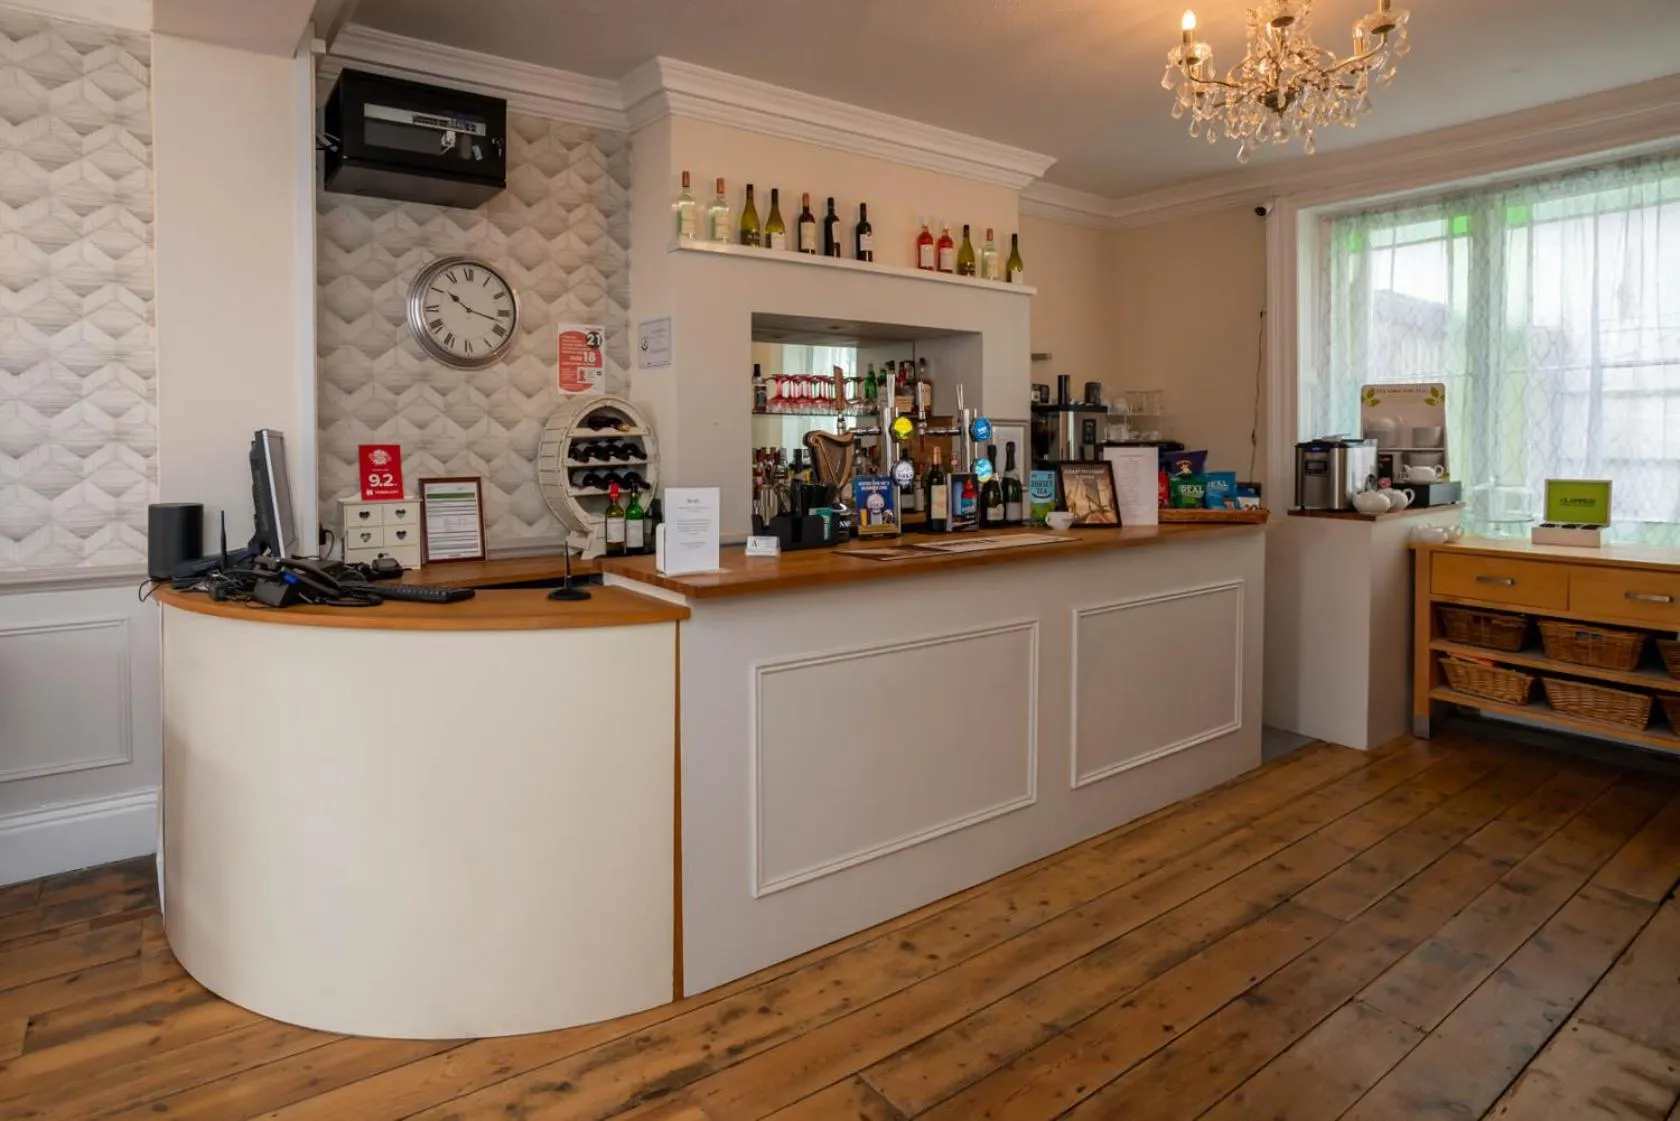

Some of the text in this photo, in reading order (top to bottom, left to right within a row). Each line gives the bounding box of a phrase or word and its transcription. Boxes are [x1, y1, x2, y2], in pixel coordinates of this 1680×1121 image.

[586, 333, 602, 346] 21
[368, 473, 394, 487] 9.2
[1179, 485, 1205, 494] REAL
